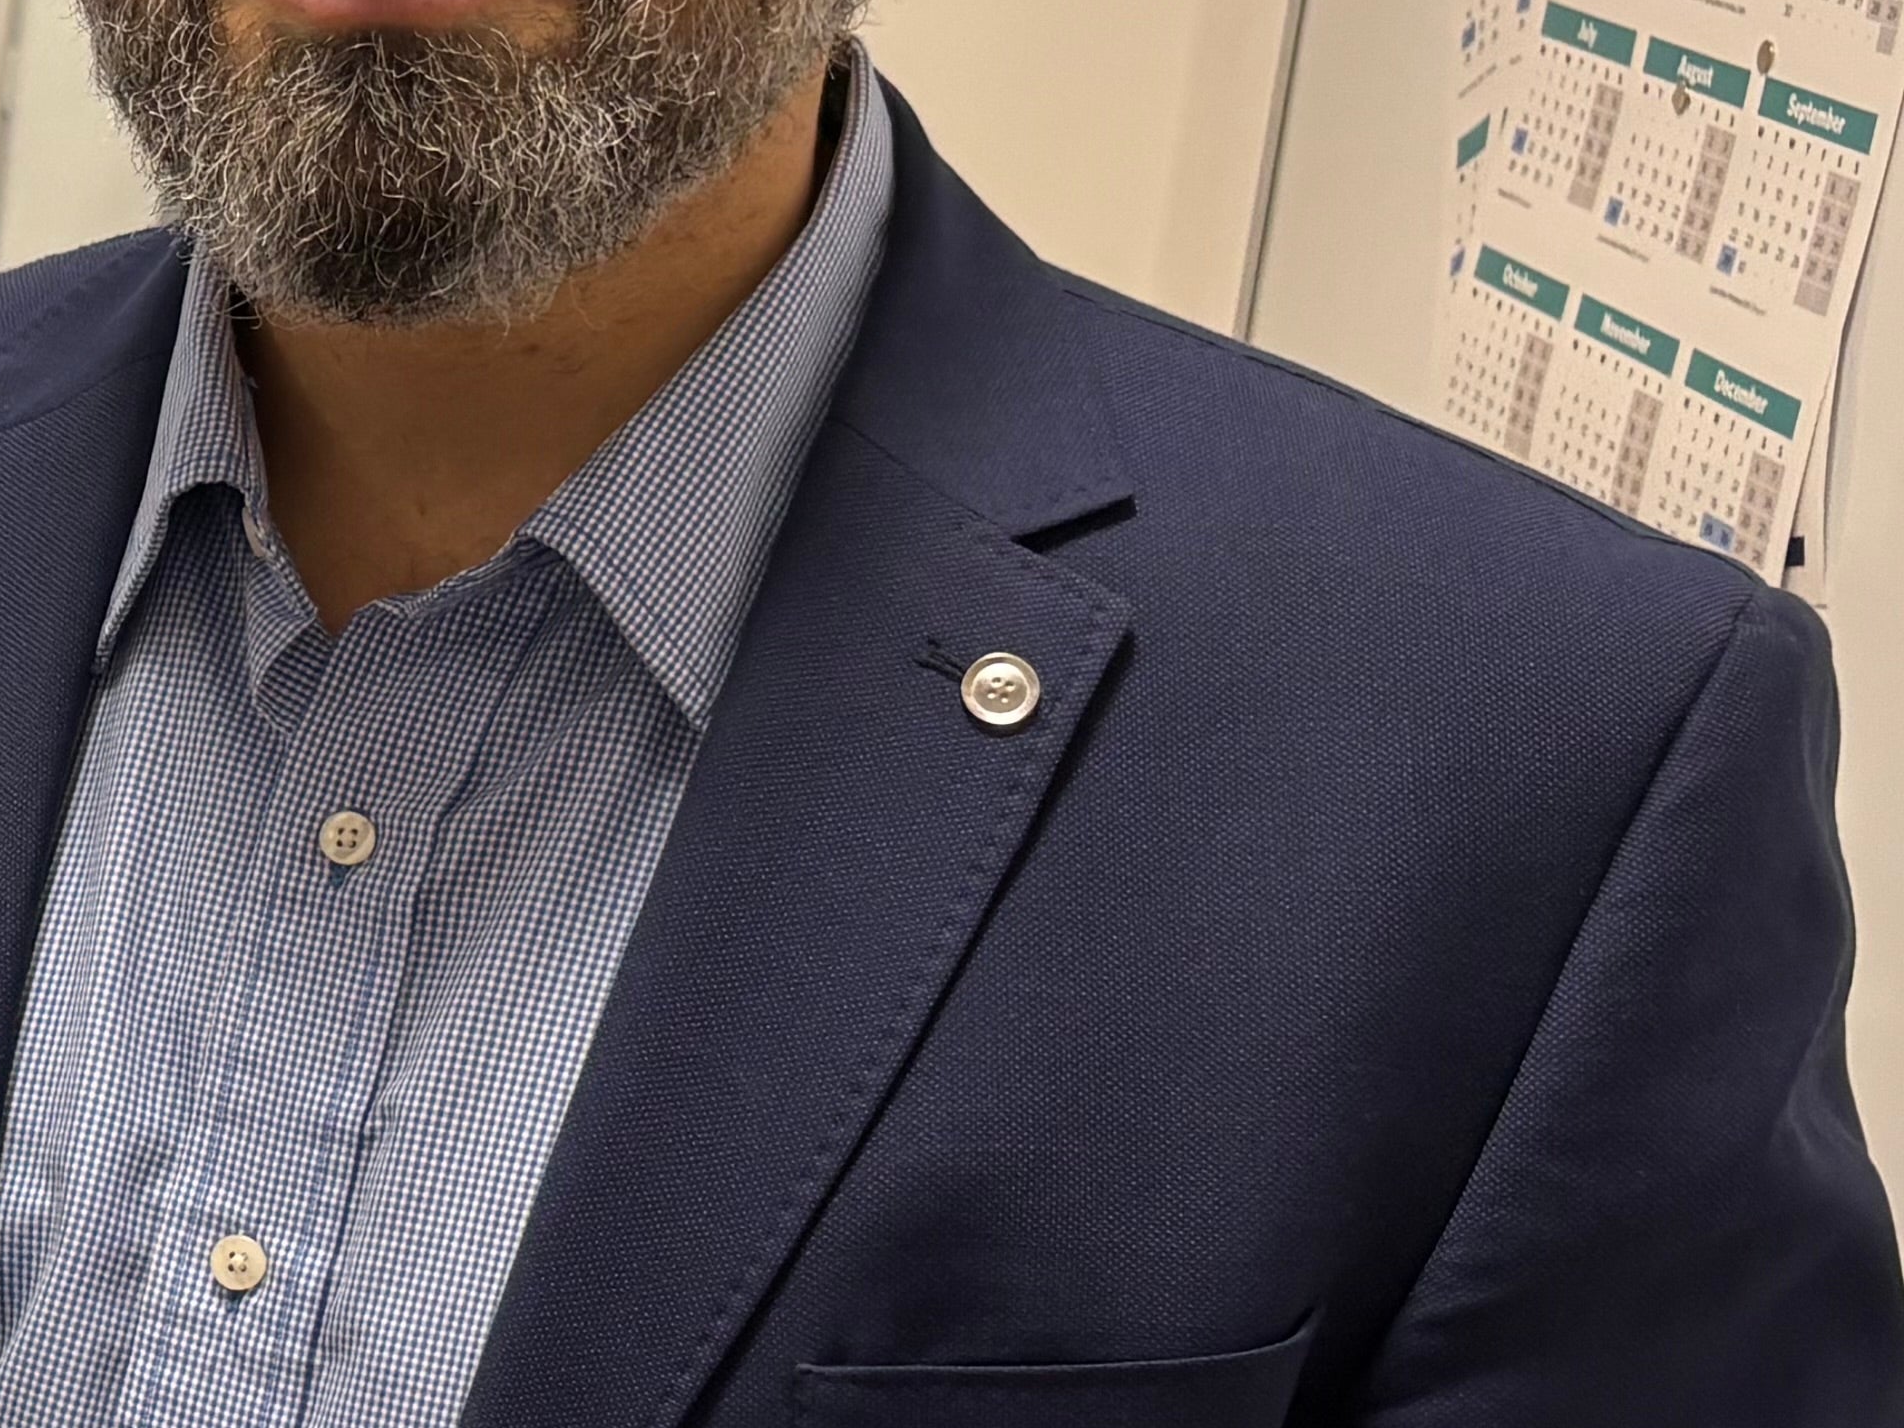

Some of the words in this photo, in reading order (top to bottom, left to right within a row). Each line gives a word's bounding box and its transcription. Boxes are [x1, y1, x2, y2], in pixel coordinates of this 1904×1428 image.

[1677, 54, 1713, 88] August
[1787, 92, 1846, 135] September
[1502, 263, 1538, 298] October
[1600, 311, 1651, 355] November
[1714, 369, 1768, 415] December
